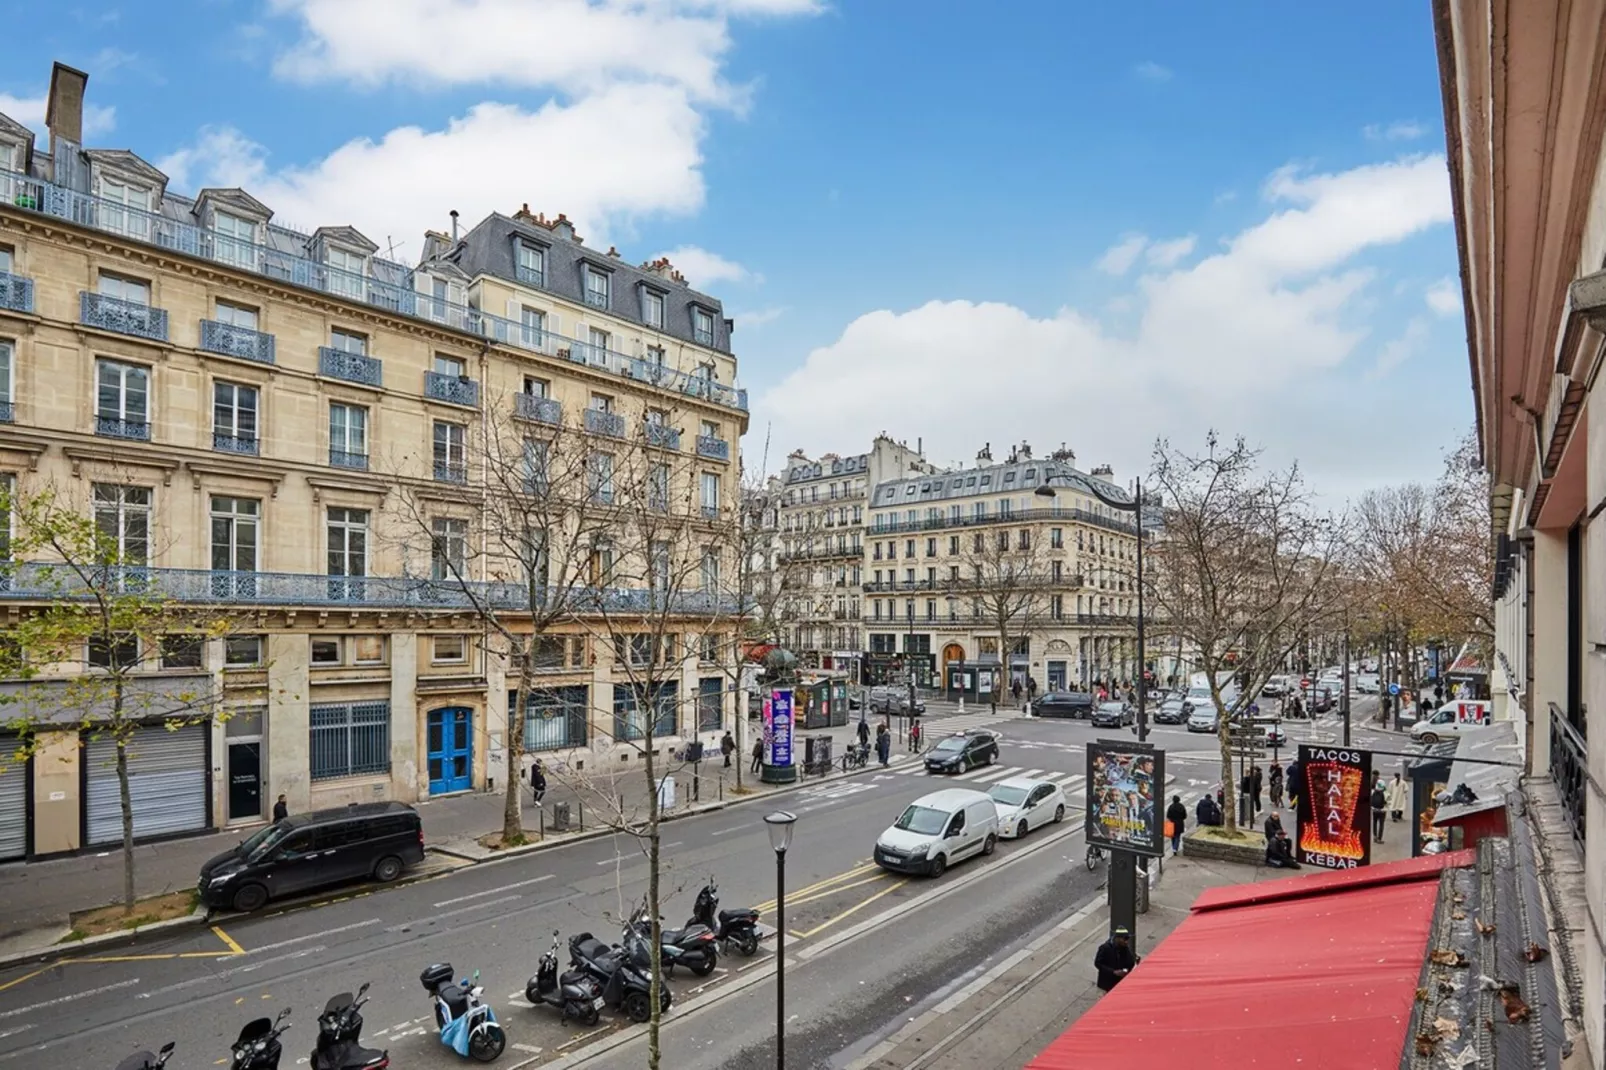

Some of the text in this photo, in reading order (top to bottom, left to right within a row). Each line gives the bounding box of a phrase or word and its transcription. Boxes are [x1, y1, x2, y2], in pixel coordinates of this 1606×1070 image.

[1308, 748, 1361, 763] TACOS
[1327, 770, 1341, 835] HALAL
[1306, 853, 1357, 868] KEBAB
